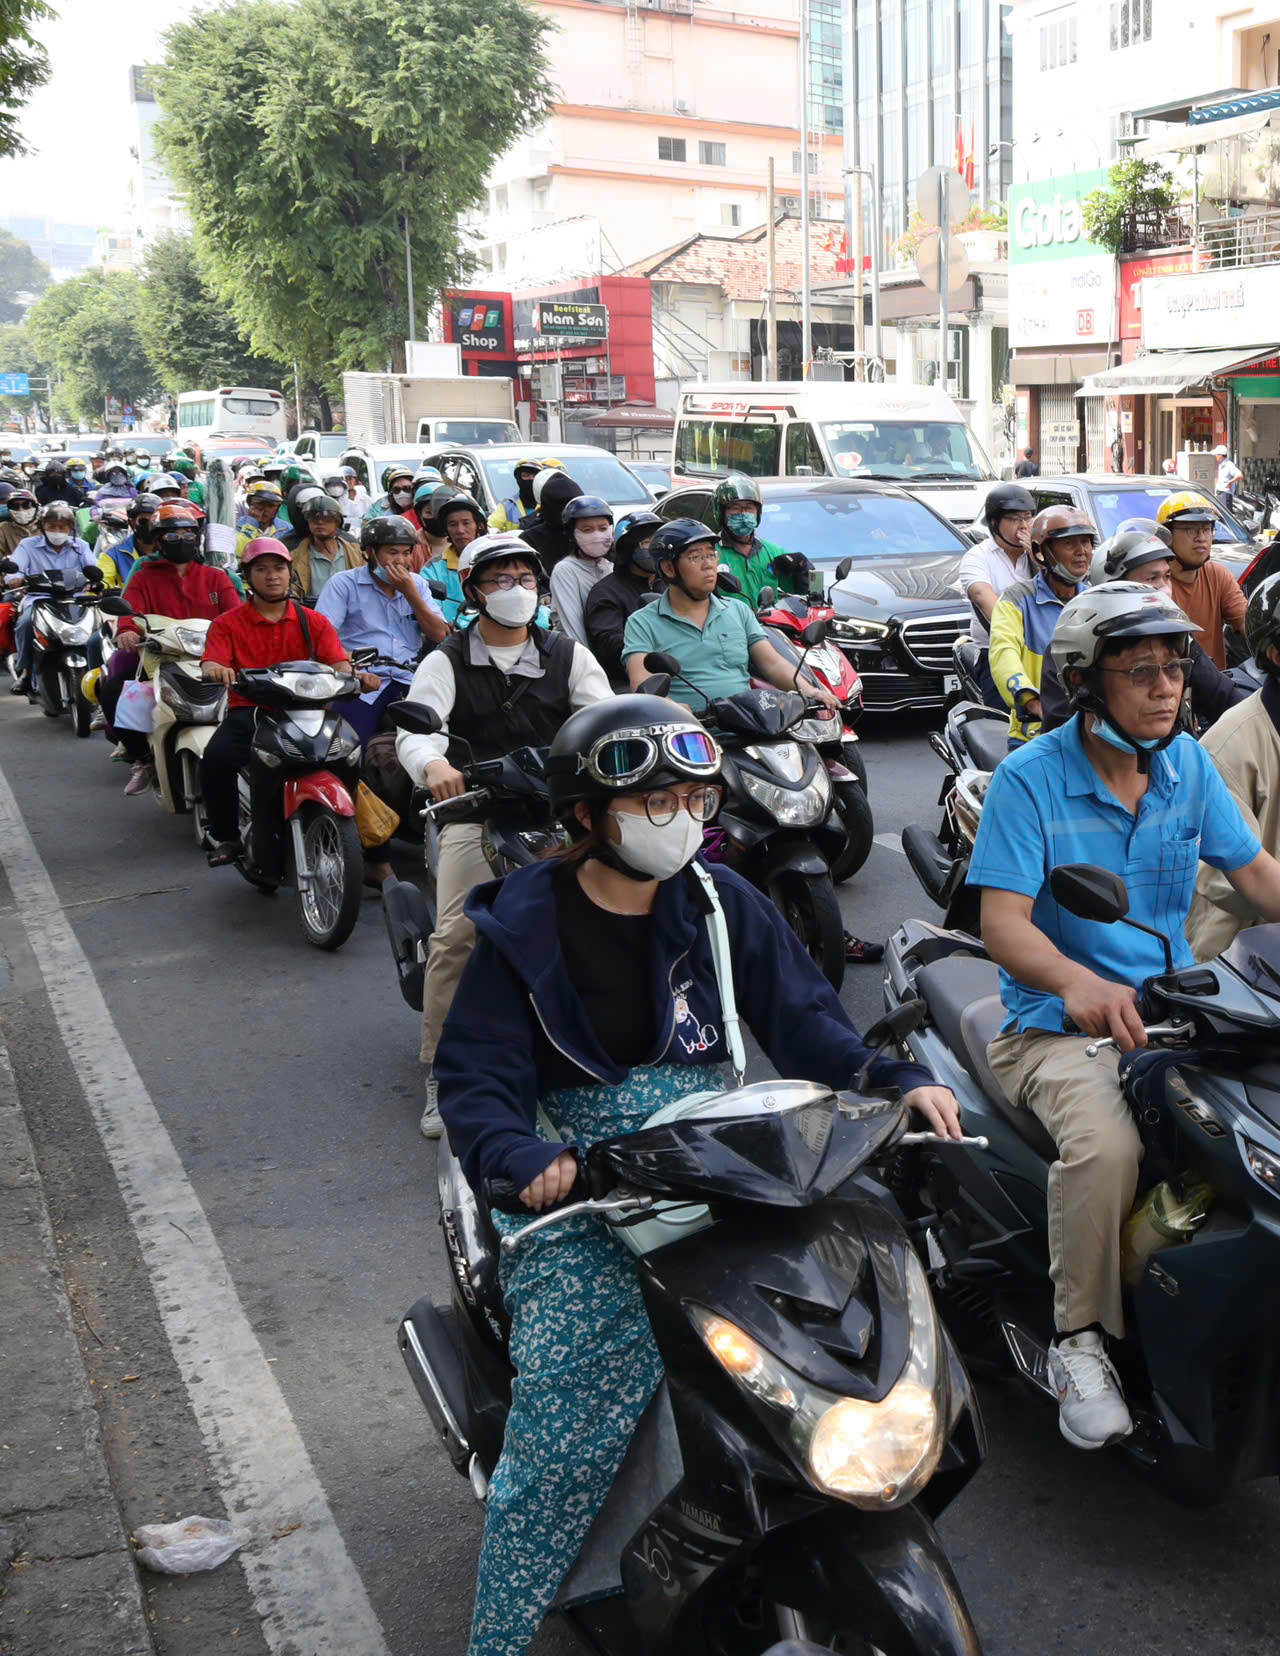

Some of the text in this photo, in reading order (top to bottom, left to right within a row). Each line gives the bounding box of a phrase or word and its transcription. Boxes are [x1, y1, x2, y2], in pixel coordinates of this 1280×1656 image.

[1015, 193, 1083, 249] Gota
[554, 304, 592, 313] Beefsteak
[542, 312, 604, 326] Nam Sơn
[462, 334, 498, 347] Shop
[680, 1498, 721, 1532] YAMAHA
